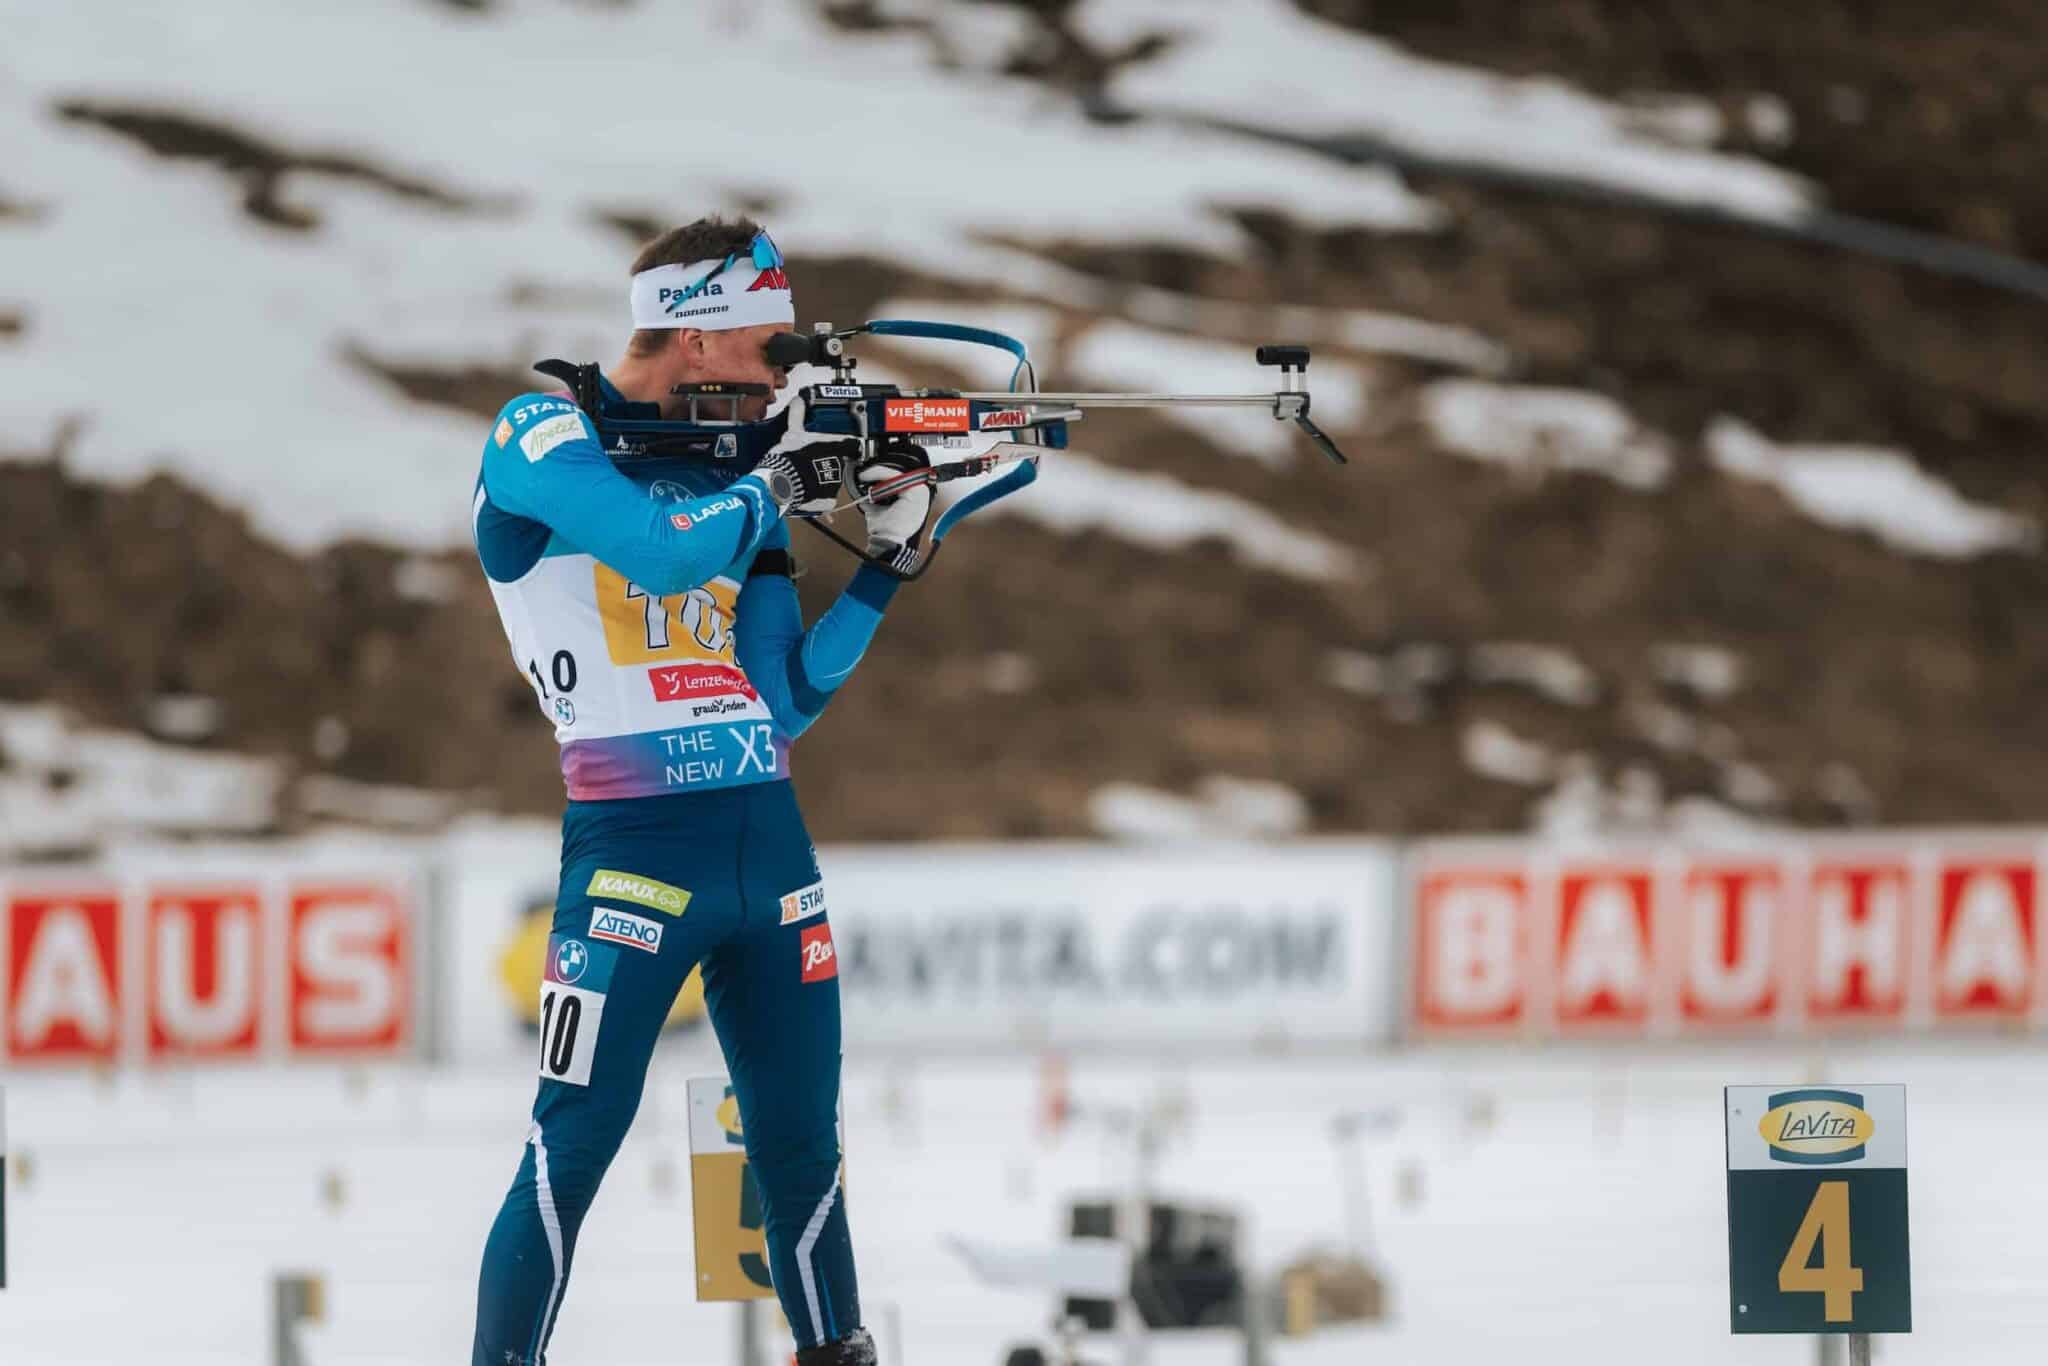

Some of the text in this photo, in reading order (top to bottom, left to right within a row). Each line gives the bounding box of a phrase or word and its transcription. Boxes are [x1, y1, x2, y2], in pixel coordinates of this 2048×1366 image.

[674, 304, 729, 319] noname
[824, 386, 860, 397] Patria
[514, 402, 585, 425] STAR
[887, 402, 968, 424] VIESSMANN
[690, 496, 746, 523] LAPUA
[659, 730, 716, 756] THE
[728, 724, 777, 776] X3
[665, 758, 724, 785] NEW
[597, 873, 660, 903] KAMUX
[593, 910, 659, 946] ATENO
[843, 904, 1349, 998] AVITA.COM
[1433, 877, 2030, 1013] BAUHA
[541, 991, 582, 1077] 10
[1778, 1180, 1864, 1323] 4
